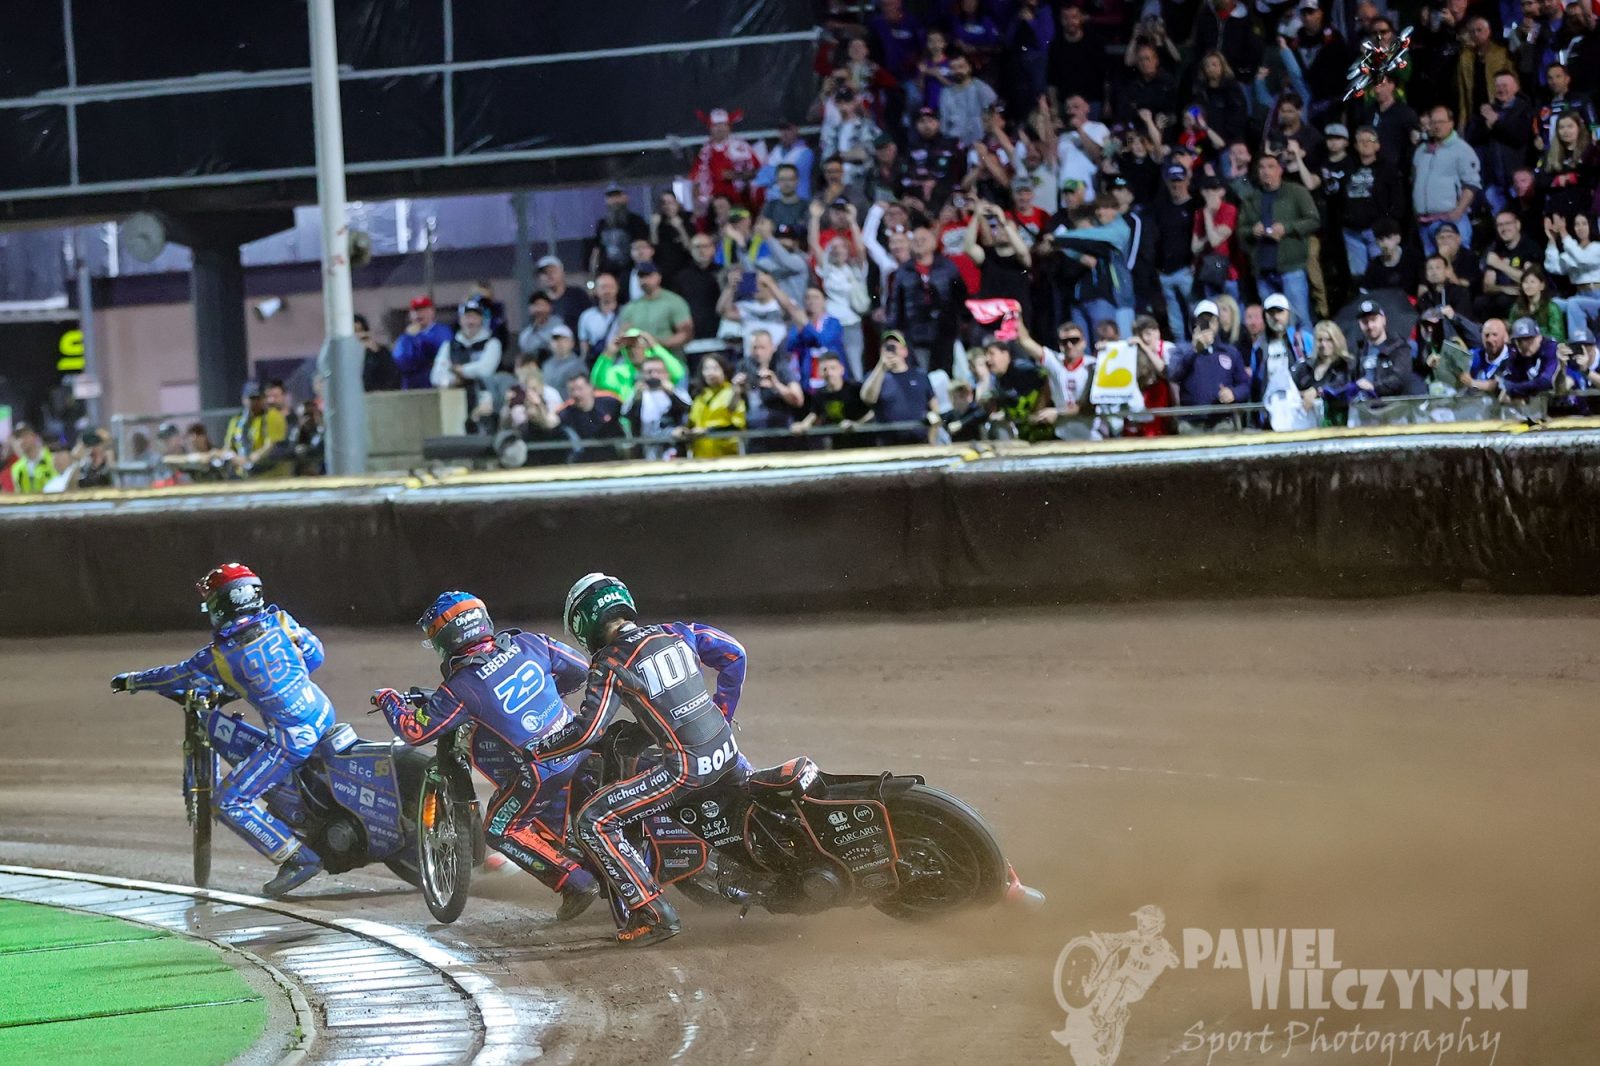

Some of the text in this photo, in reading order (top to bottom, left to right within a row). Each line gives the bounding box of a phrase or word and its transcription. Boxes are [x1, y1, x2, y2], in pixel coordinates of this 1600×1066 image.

[597, 591, 623, 608] BOLL
[241, 632, 290, 693] 95
[475, 644, 522, 680] LEBEDEVS
[635, 639, 700, 699] 101
[493, 660, 545, 714] 29
[607, 781, 648, 805] Richard
[244, 820, 279, 849] PROFBUD
[702, 817, 729, 832] M & J
[703, 825, 731, 839] Sealey
[835, 823, 851, 832] BOLL
[841, 847, 871, 860] EASTERN
